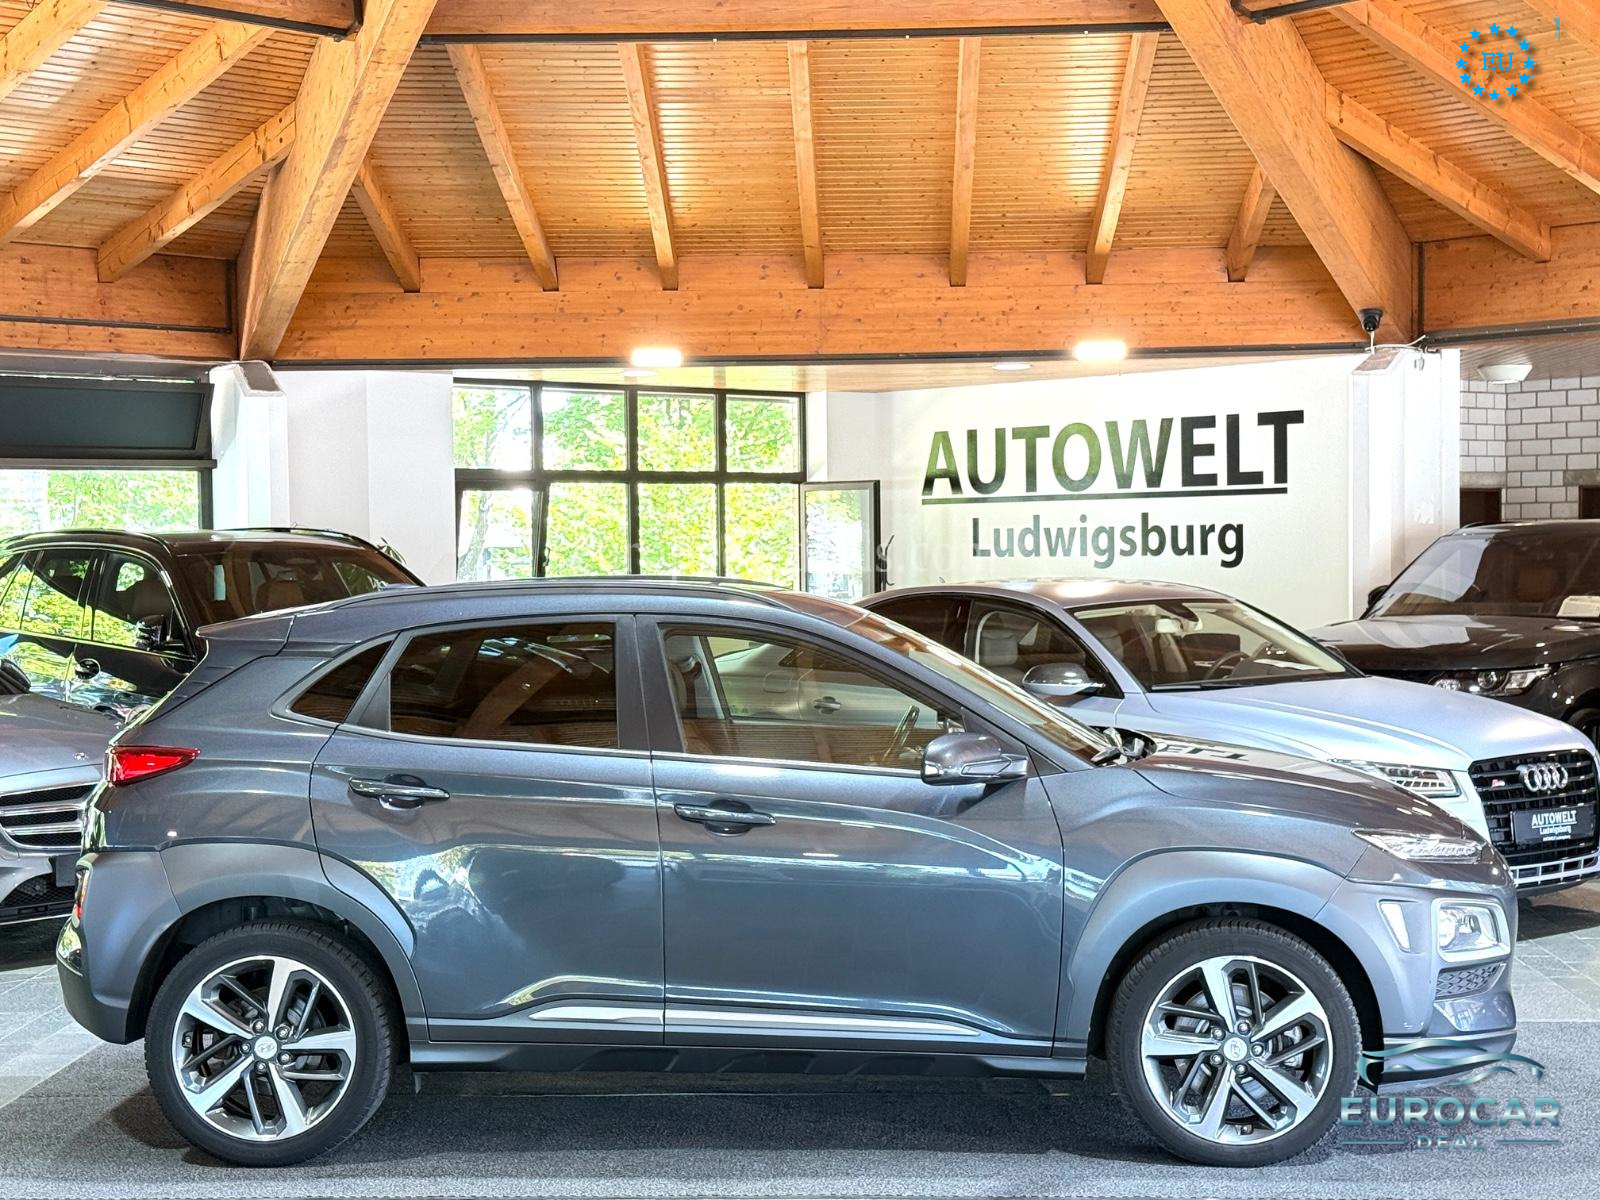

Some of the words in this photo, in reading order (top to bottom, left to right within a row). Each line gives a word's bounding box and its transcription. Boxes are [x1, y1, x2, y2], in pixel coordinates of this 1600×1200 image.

[922, 410, 1304, 496] AUTOWELT
[972, 512, 1245, 569] Ludwigsburg
[1531, 810, 1577, 826] AUTOWELT
